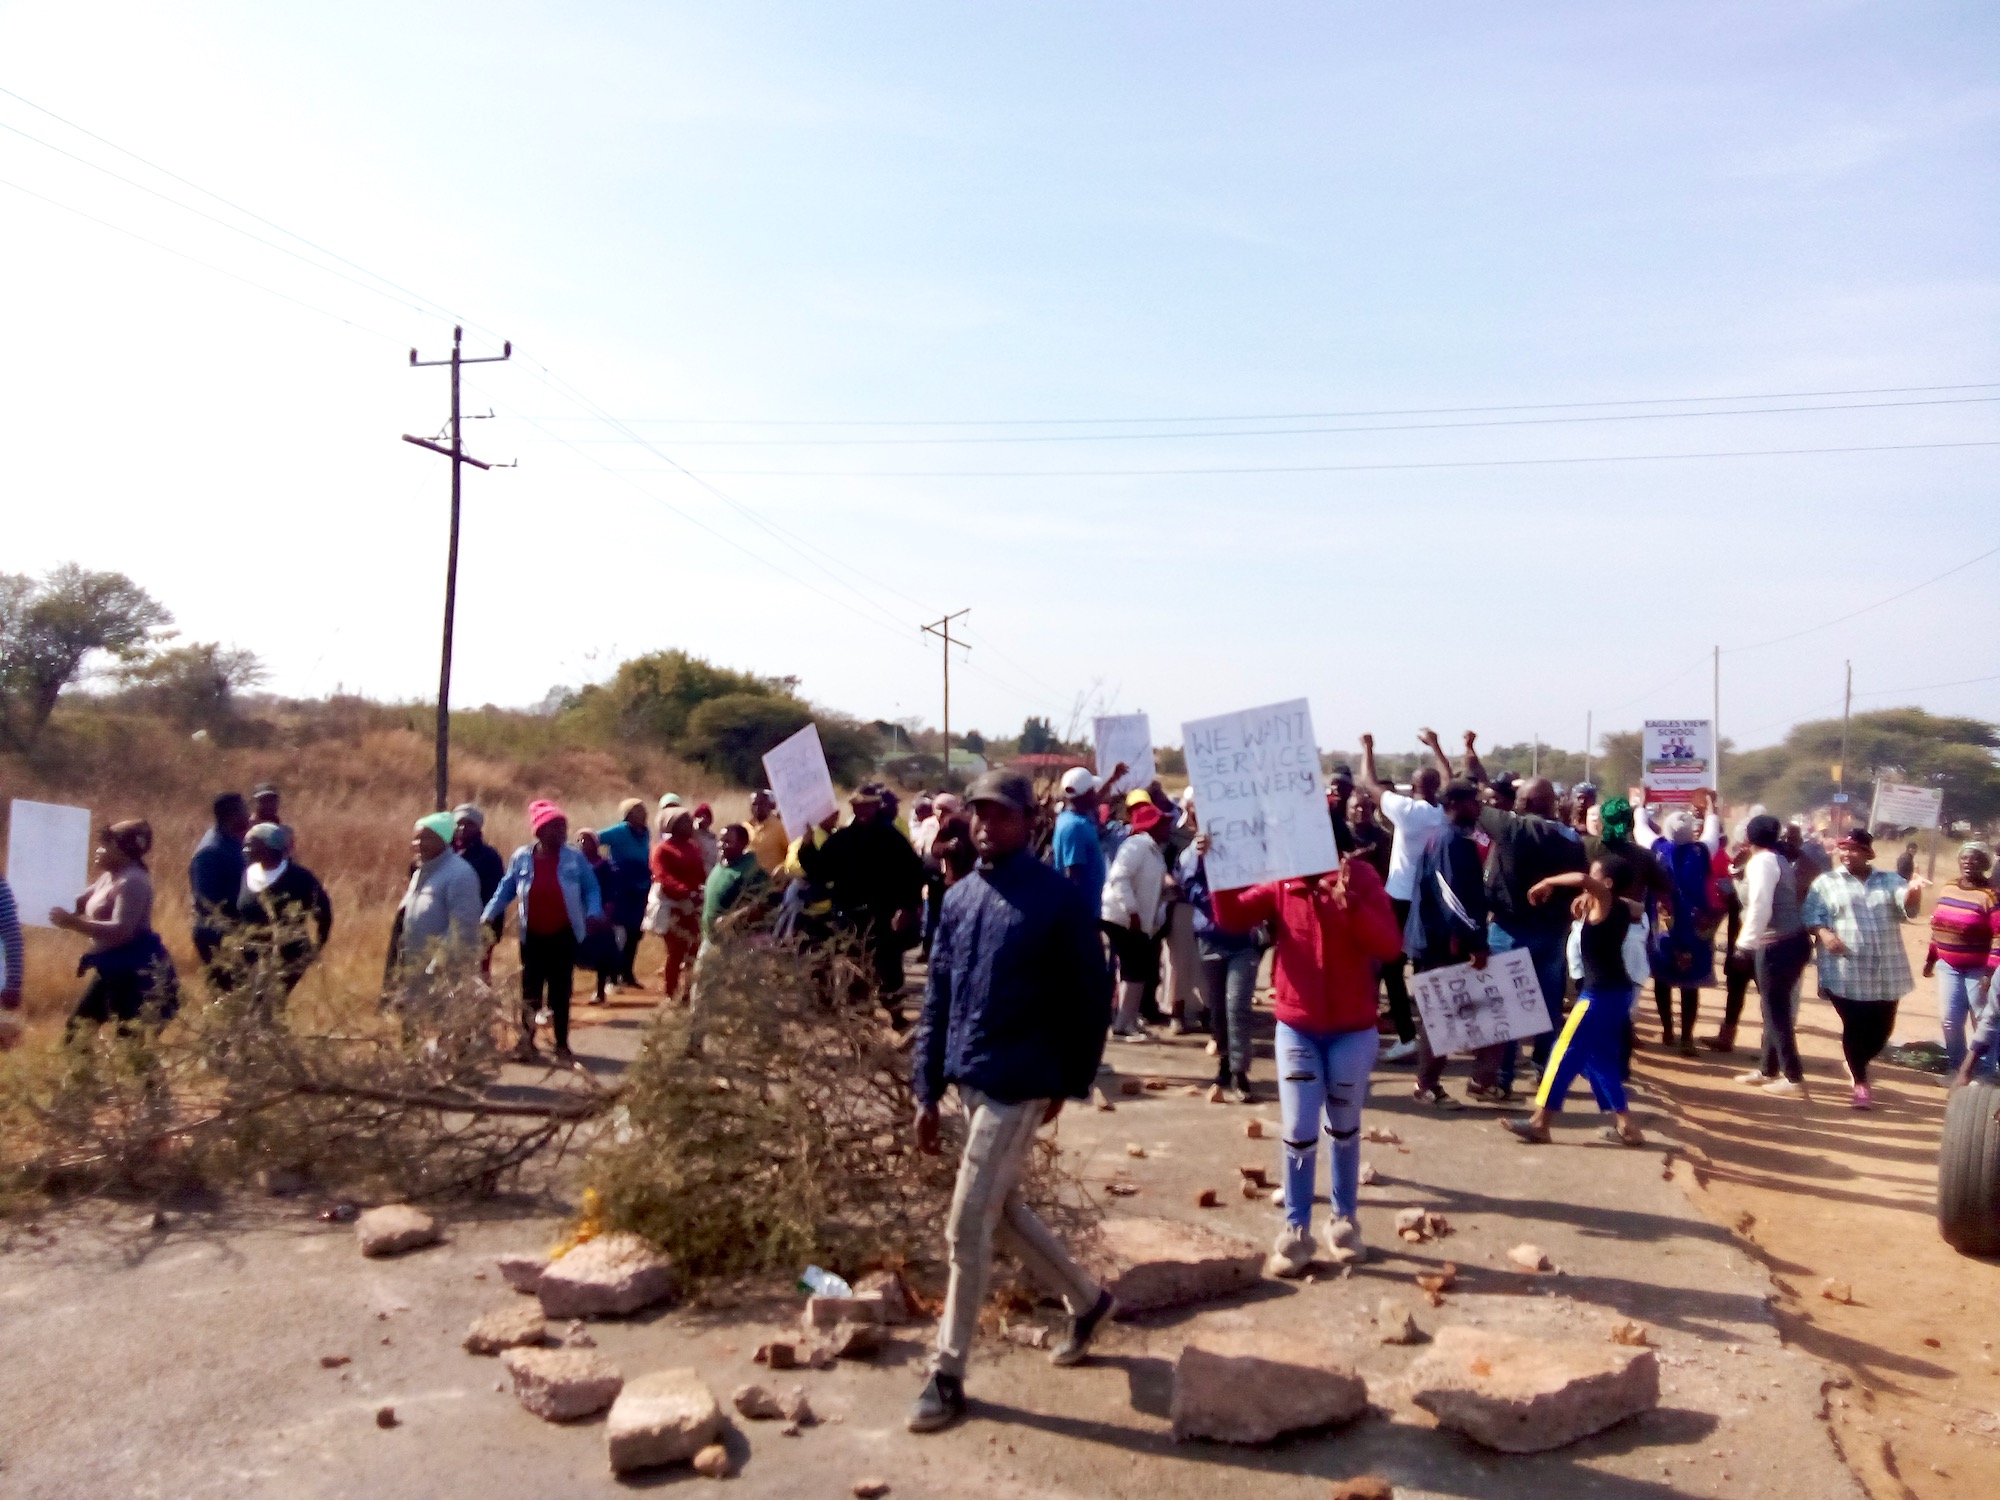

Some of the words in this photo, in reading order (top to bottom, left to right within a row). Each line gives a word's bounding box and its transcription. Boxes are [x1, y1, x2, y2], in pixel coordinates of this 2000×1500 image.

[1192, 728, 1230, 756] WE
[1243, 713, 1306, 747] WANT
[1658, 728, 1697, 736] SCHOOL
[1197, 745, 1312, 779] SERVICE
[1505, 959, 1537, 1012] NEED
